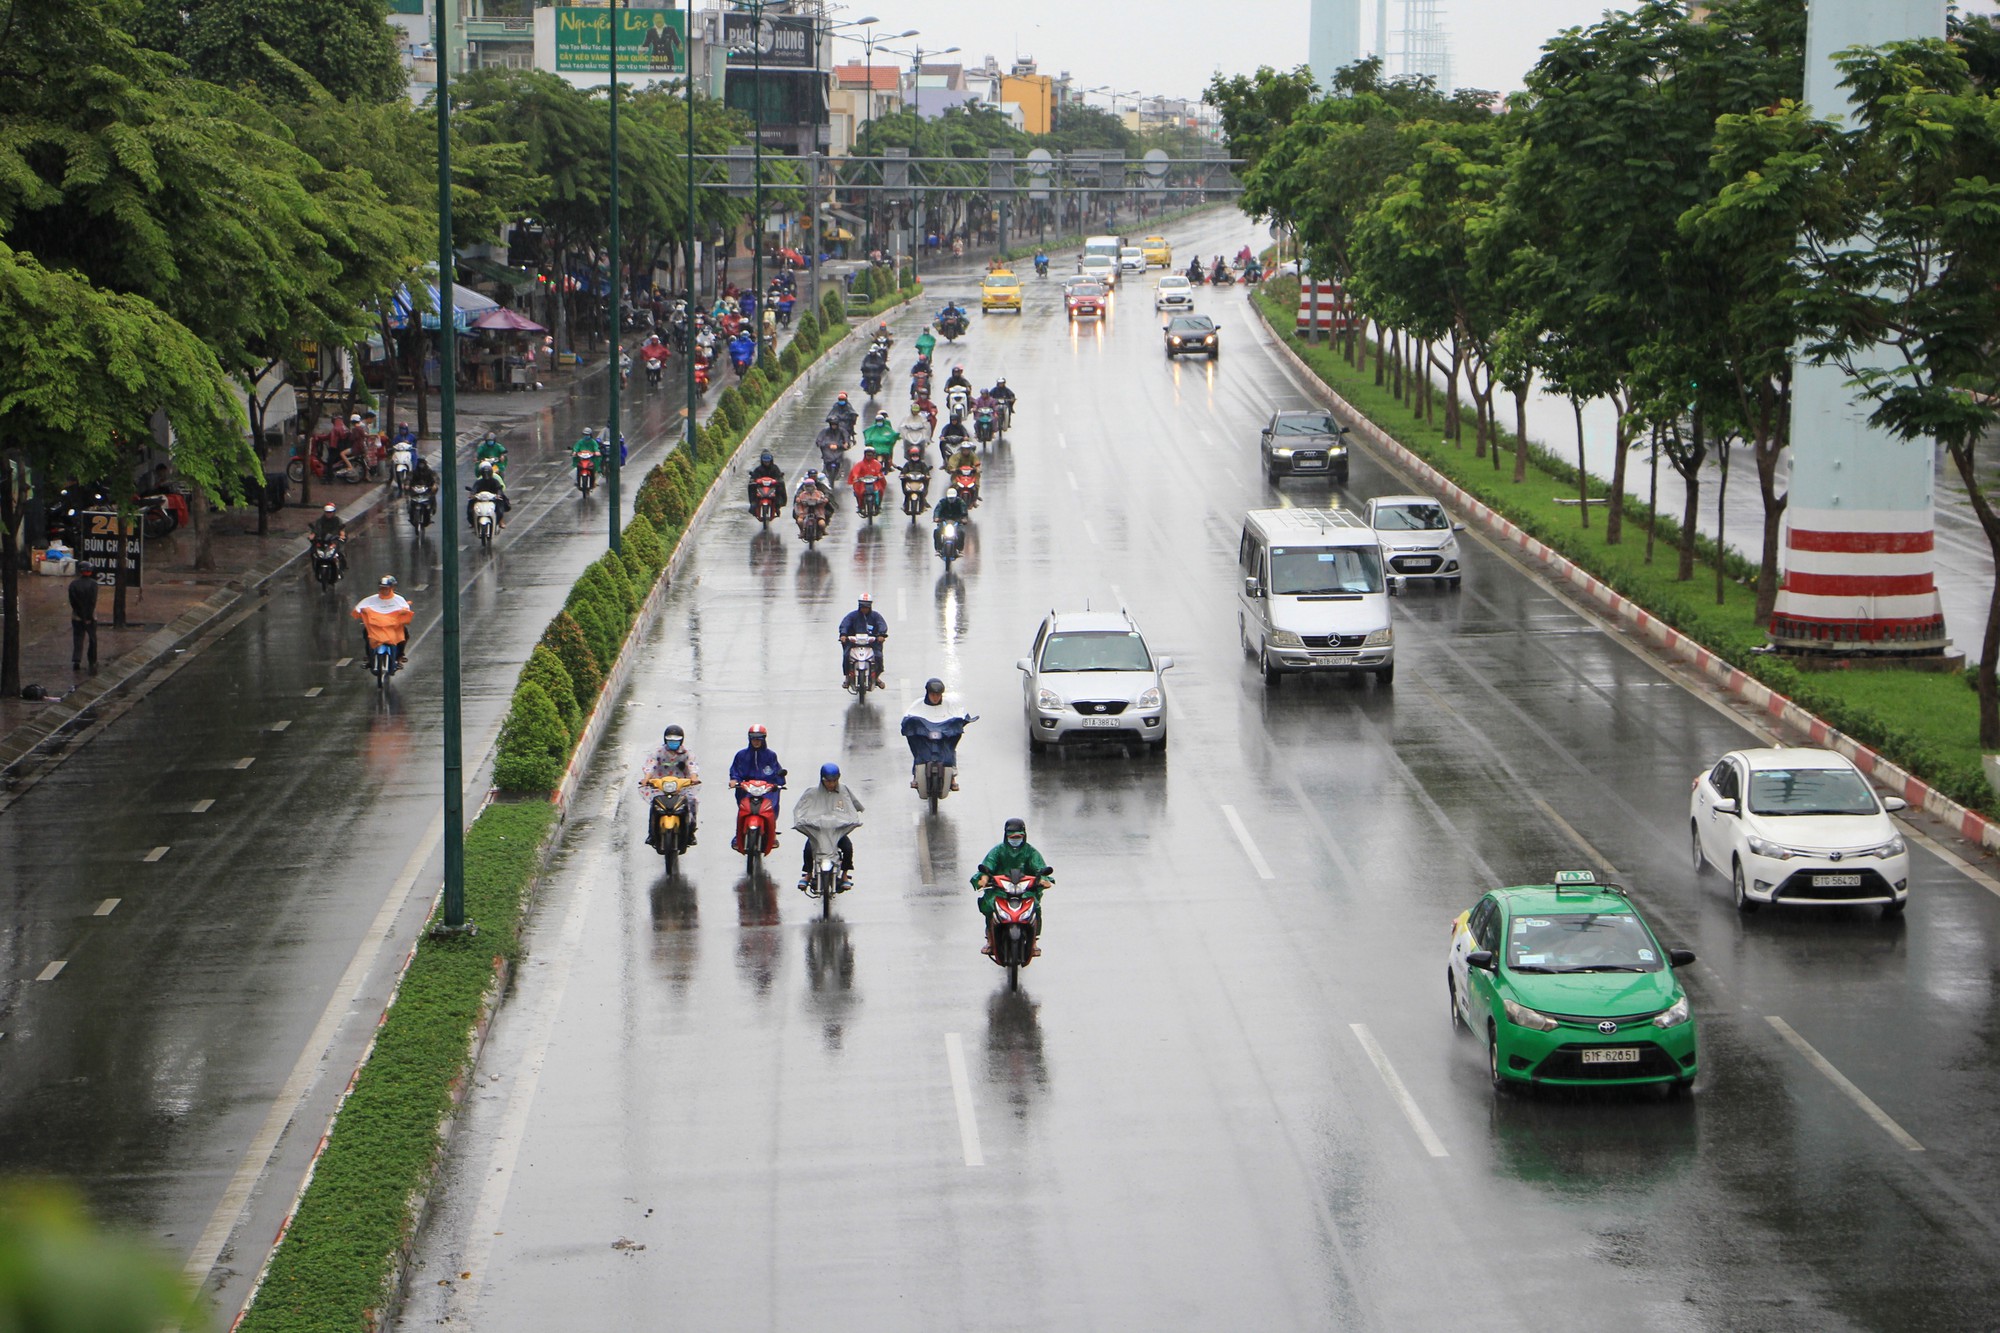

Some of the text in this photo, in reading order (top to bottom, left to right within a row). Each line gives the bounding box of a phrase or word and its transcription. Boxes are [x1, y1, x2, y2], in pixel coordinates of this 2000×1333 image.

[624, 11, 649, 31] Lộc
[775, 26, 805, 50] HÙNG
[84, 537, 140, 553] BÚN CH CÁ
[96, 572, 116, 586] 25
